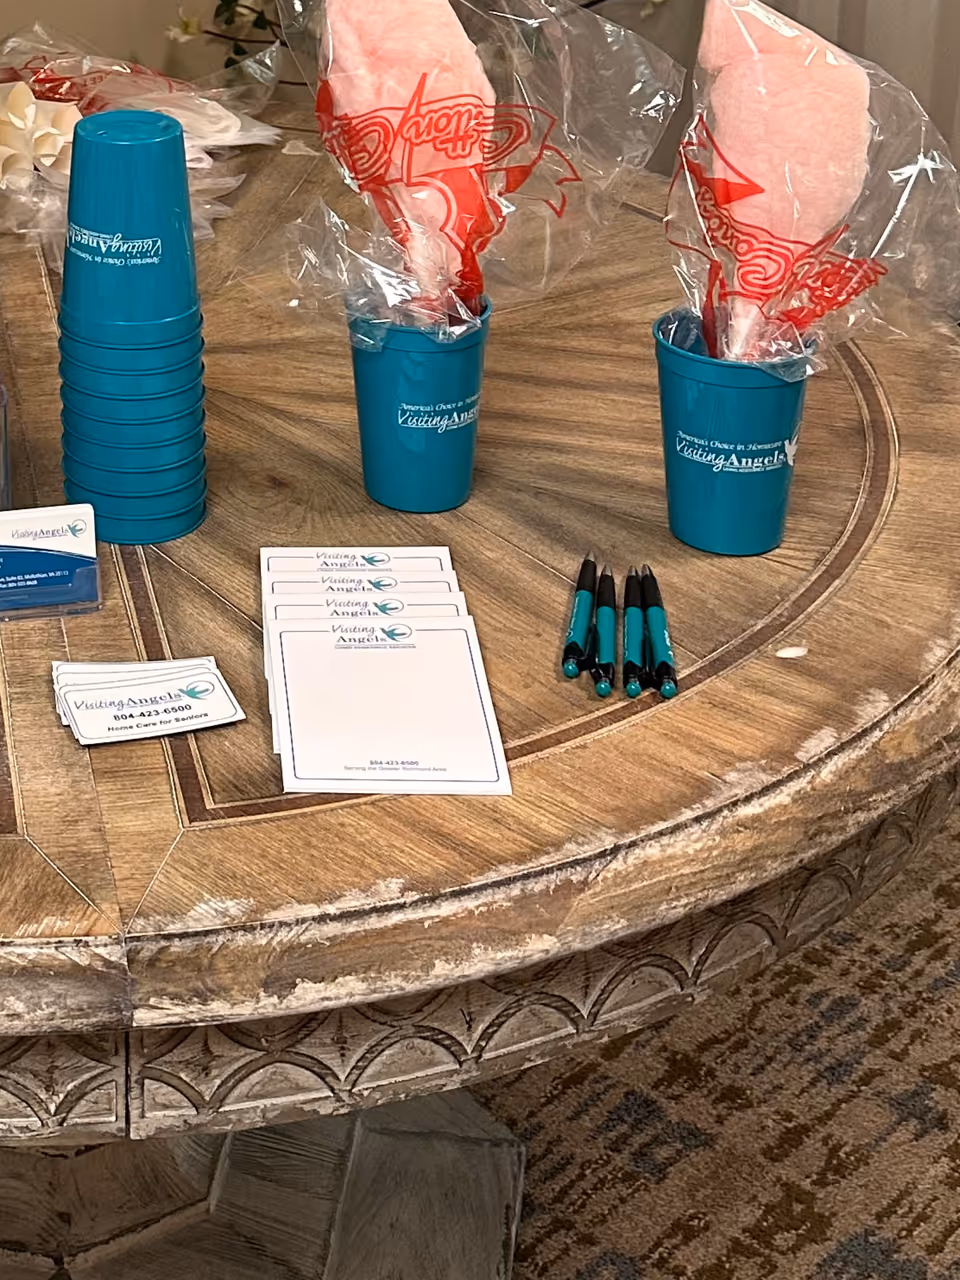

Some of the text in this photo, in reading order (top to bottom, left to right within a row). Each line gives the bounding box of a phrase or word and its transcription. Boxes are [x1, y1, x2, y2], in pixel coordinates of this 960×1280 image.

[398, 409, 449, 433] Visiting
[676, 437, 785, 472] Visiting Angels
[315, 551, 358, 561] Visiting
[321, 576, 364, 587] Visiting
[325, 599, 370, 610] Visiting
[331, 624, 376, 637] Visiting
[74, 698, 127, 712] Visiting
[126, 691, 183, 706] Angels
[113, 703, 192, 721] 804-423-6500
[107, 724, 134, 732] Home
[135, 721, 158, 729] Care
